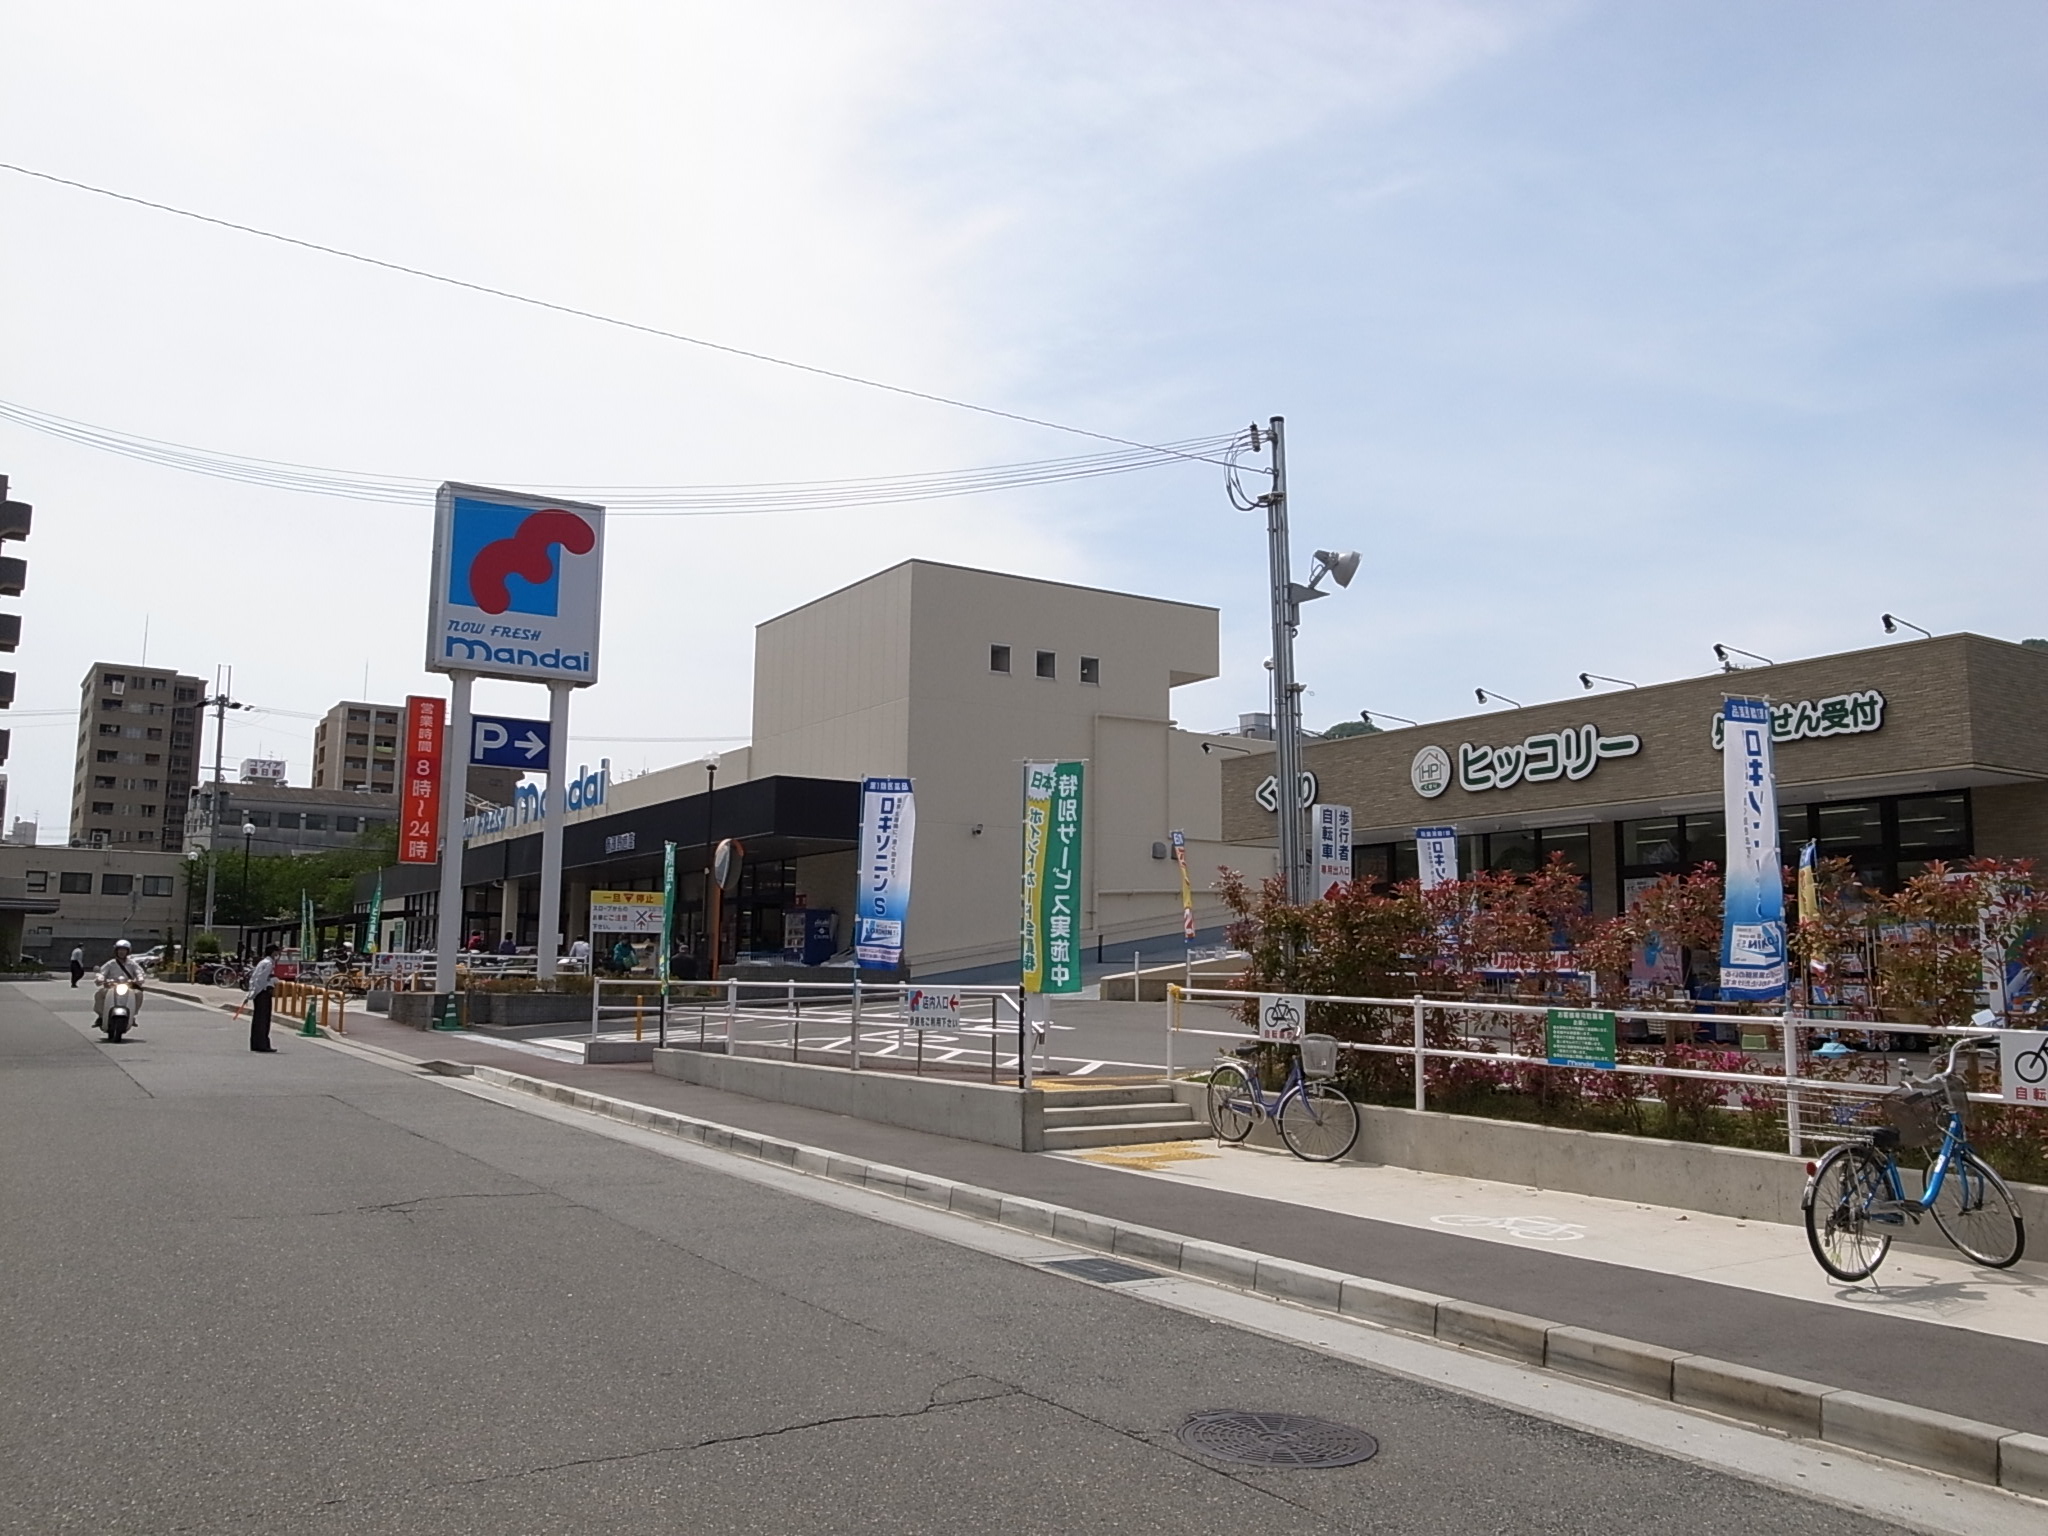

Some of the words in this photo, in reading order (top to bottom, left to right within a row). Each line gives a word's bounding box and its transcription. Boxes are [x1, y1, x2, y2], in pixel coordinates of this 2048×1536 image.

[445, 635, 590, 672] mandai
[490, 625, 542, 642] FRESH
[417, 702, 434, 753] 営業時間
[474, 722, 508, 760] P
[1711, 690, 1884, 749] せん受付
[1421, 763, 1439, 780] HP
[1459, 724, 1639, 791] ヒッコリー
[514, 758, 609, 826] mdai
[1256, 771, 1316, 811] くり
[1321, 808, 1334, 860] 自転車
[1338, 810, 1350, 861] 歩行者
[636, 893, 654, 904] 停止
